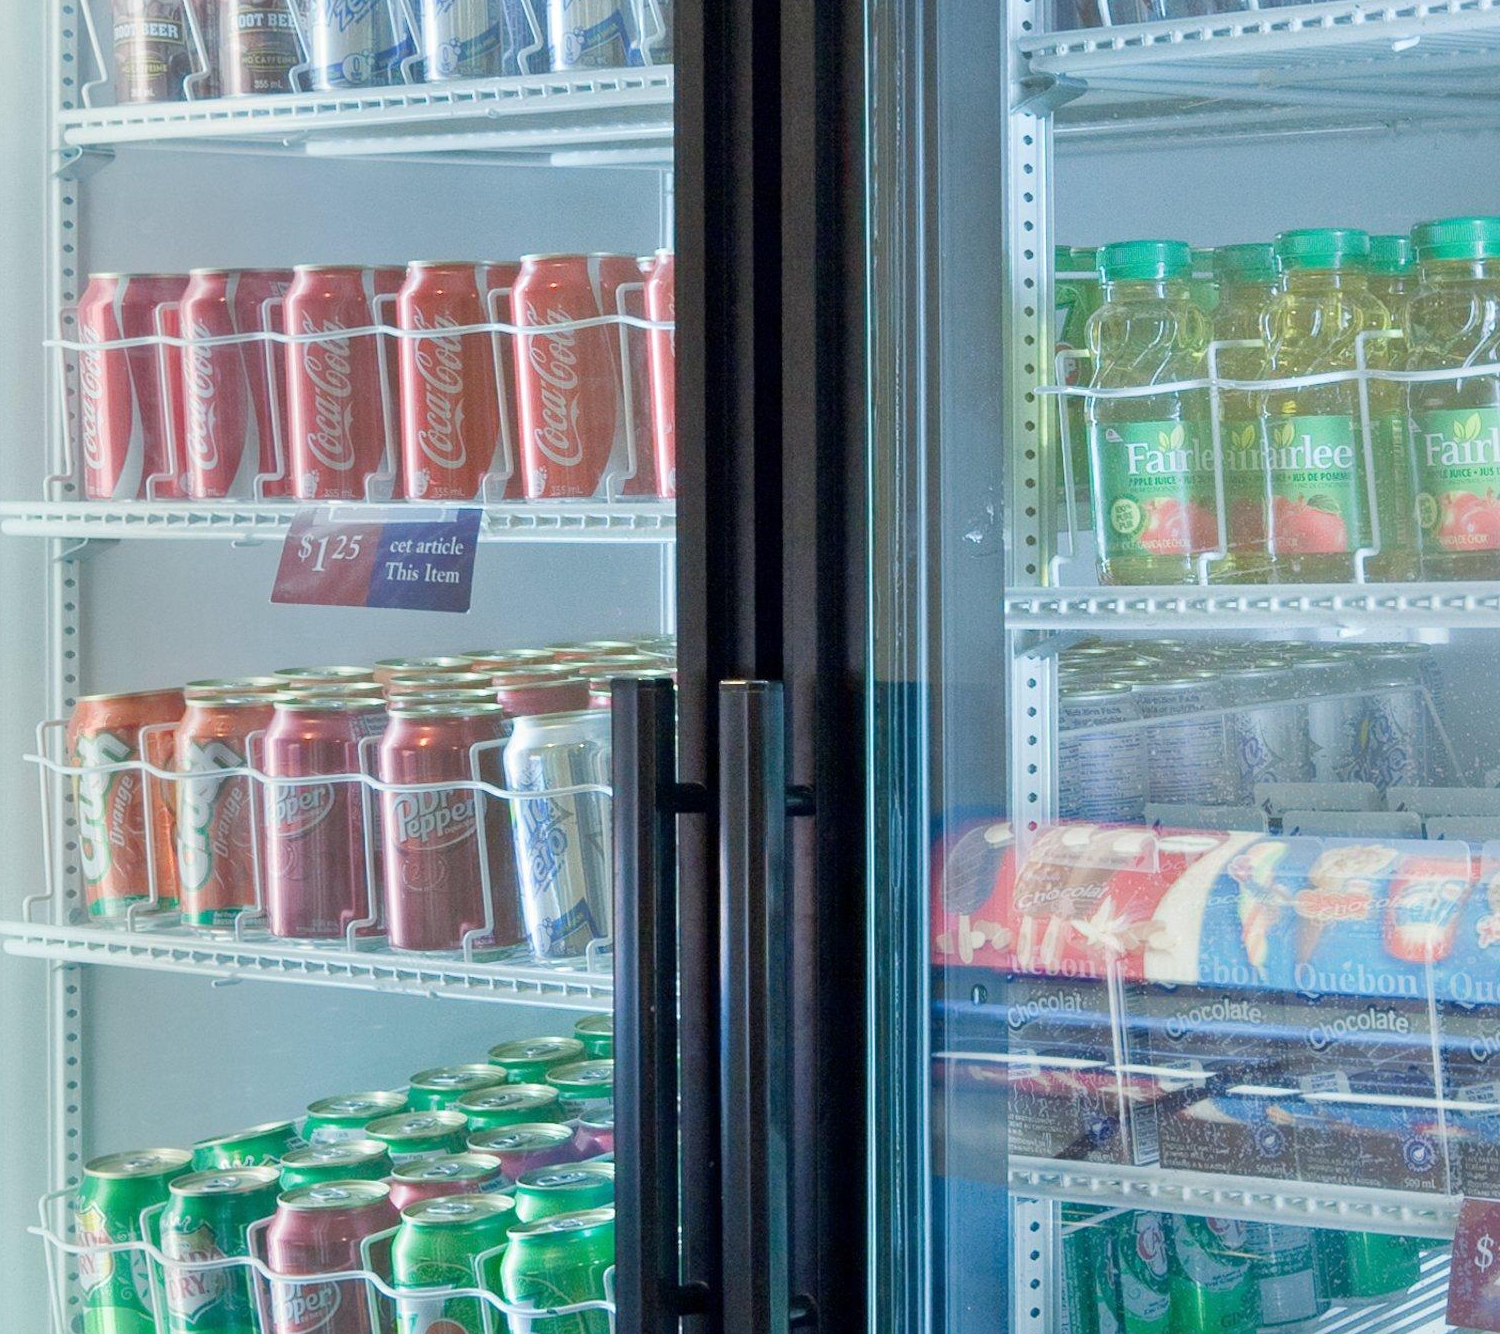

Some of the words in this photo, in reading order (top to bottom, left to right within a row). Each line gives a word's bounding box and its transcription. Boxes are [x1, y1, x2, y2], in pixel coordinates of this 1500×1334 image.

[390, 537, 412, 555] cet
[416, 537, 464, 556] article
[385, 561, 421, 583] This
[425, 564, 461, 584] Item
[108, 772, 136, 849] Orange
[212, 785, 244, 857] Orange
